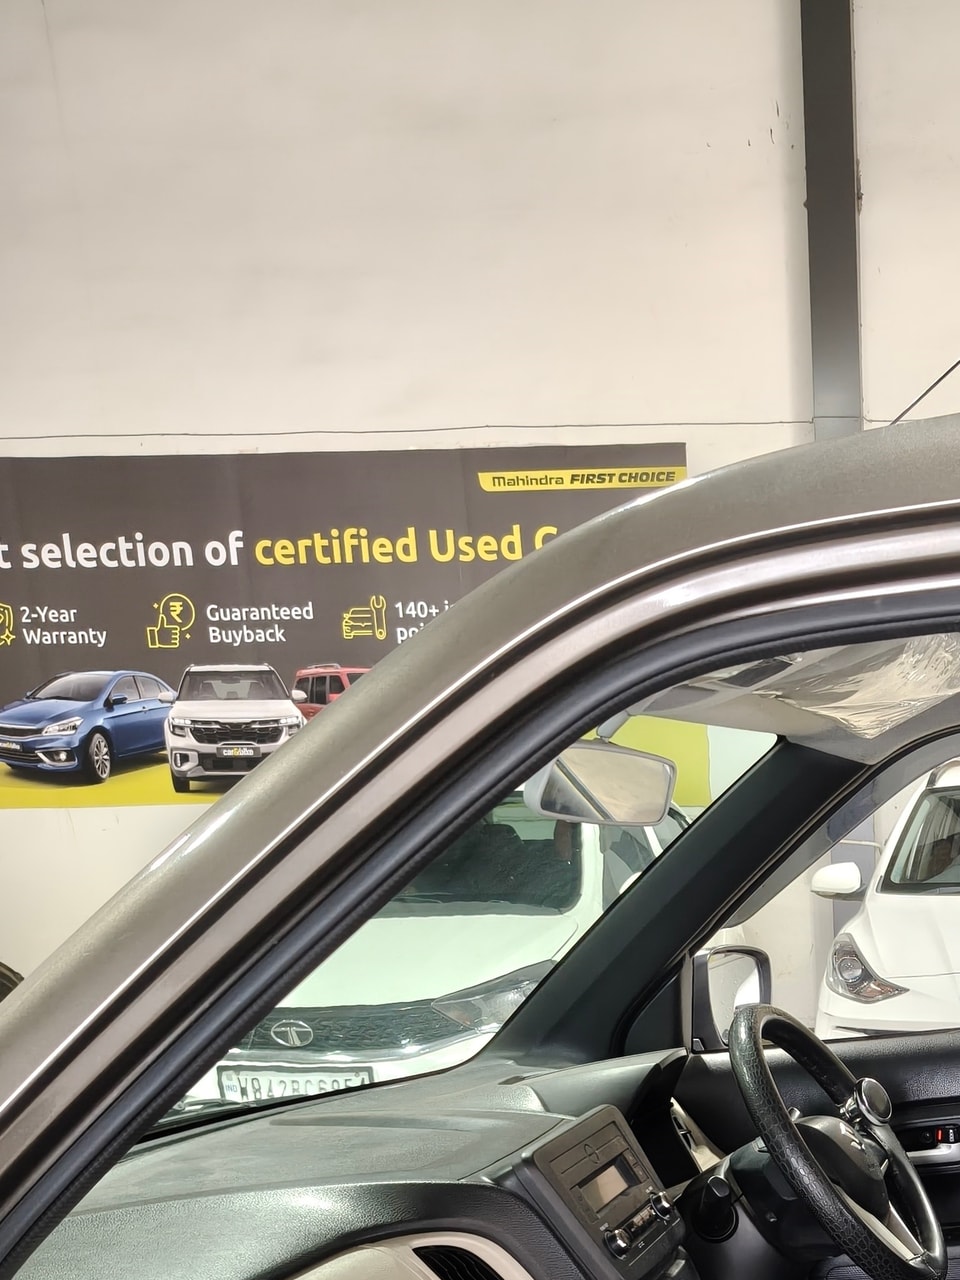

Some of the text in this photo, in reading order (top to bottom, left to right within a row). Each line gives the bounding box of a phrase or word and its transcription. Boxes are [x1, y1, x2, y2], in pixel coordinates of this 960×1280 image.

[491, 471, 676, 487] Mahindra FIRST CHOICE
[21, 532, 194, 569] selection
[205, 530, 244, 566] of
[255, 527, 418, 566] certified
[428, 524, 524, 562] Used
[20, 606, 77, 623] 2-Year
[206, 601, 314, 622] Guaranteed
[395, 601, 440, 618] 140+
[22, 628, 107, 648] Warranty
[208, 625, 287, 647] Buyback
